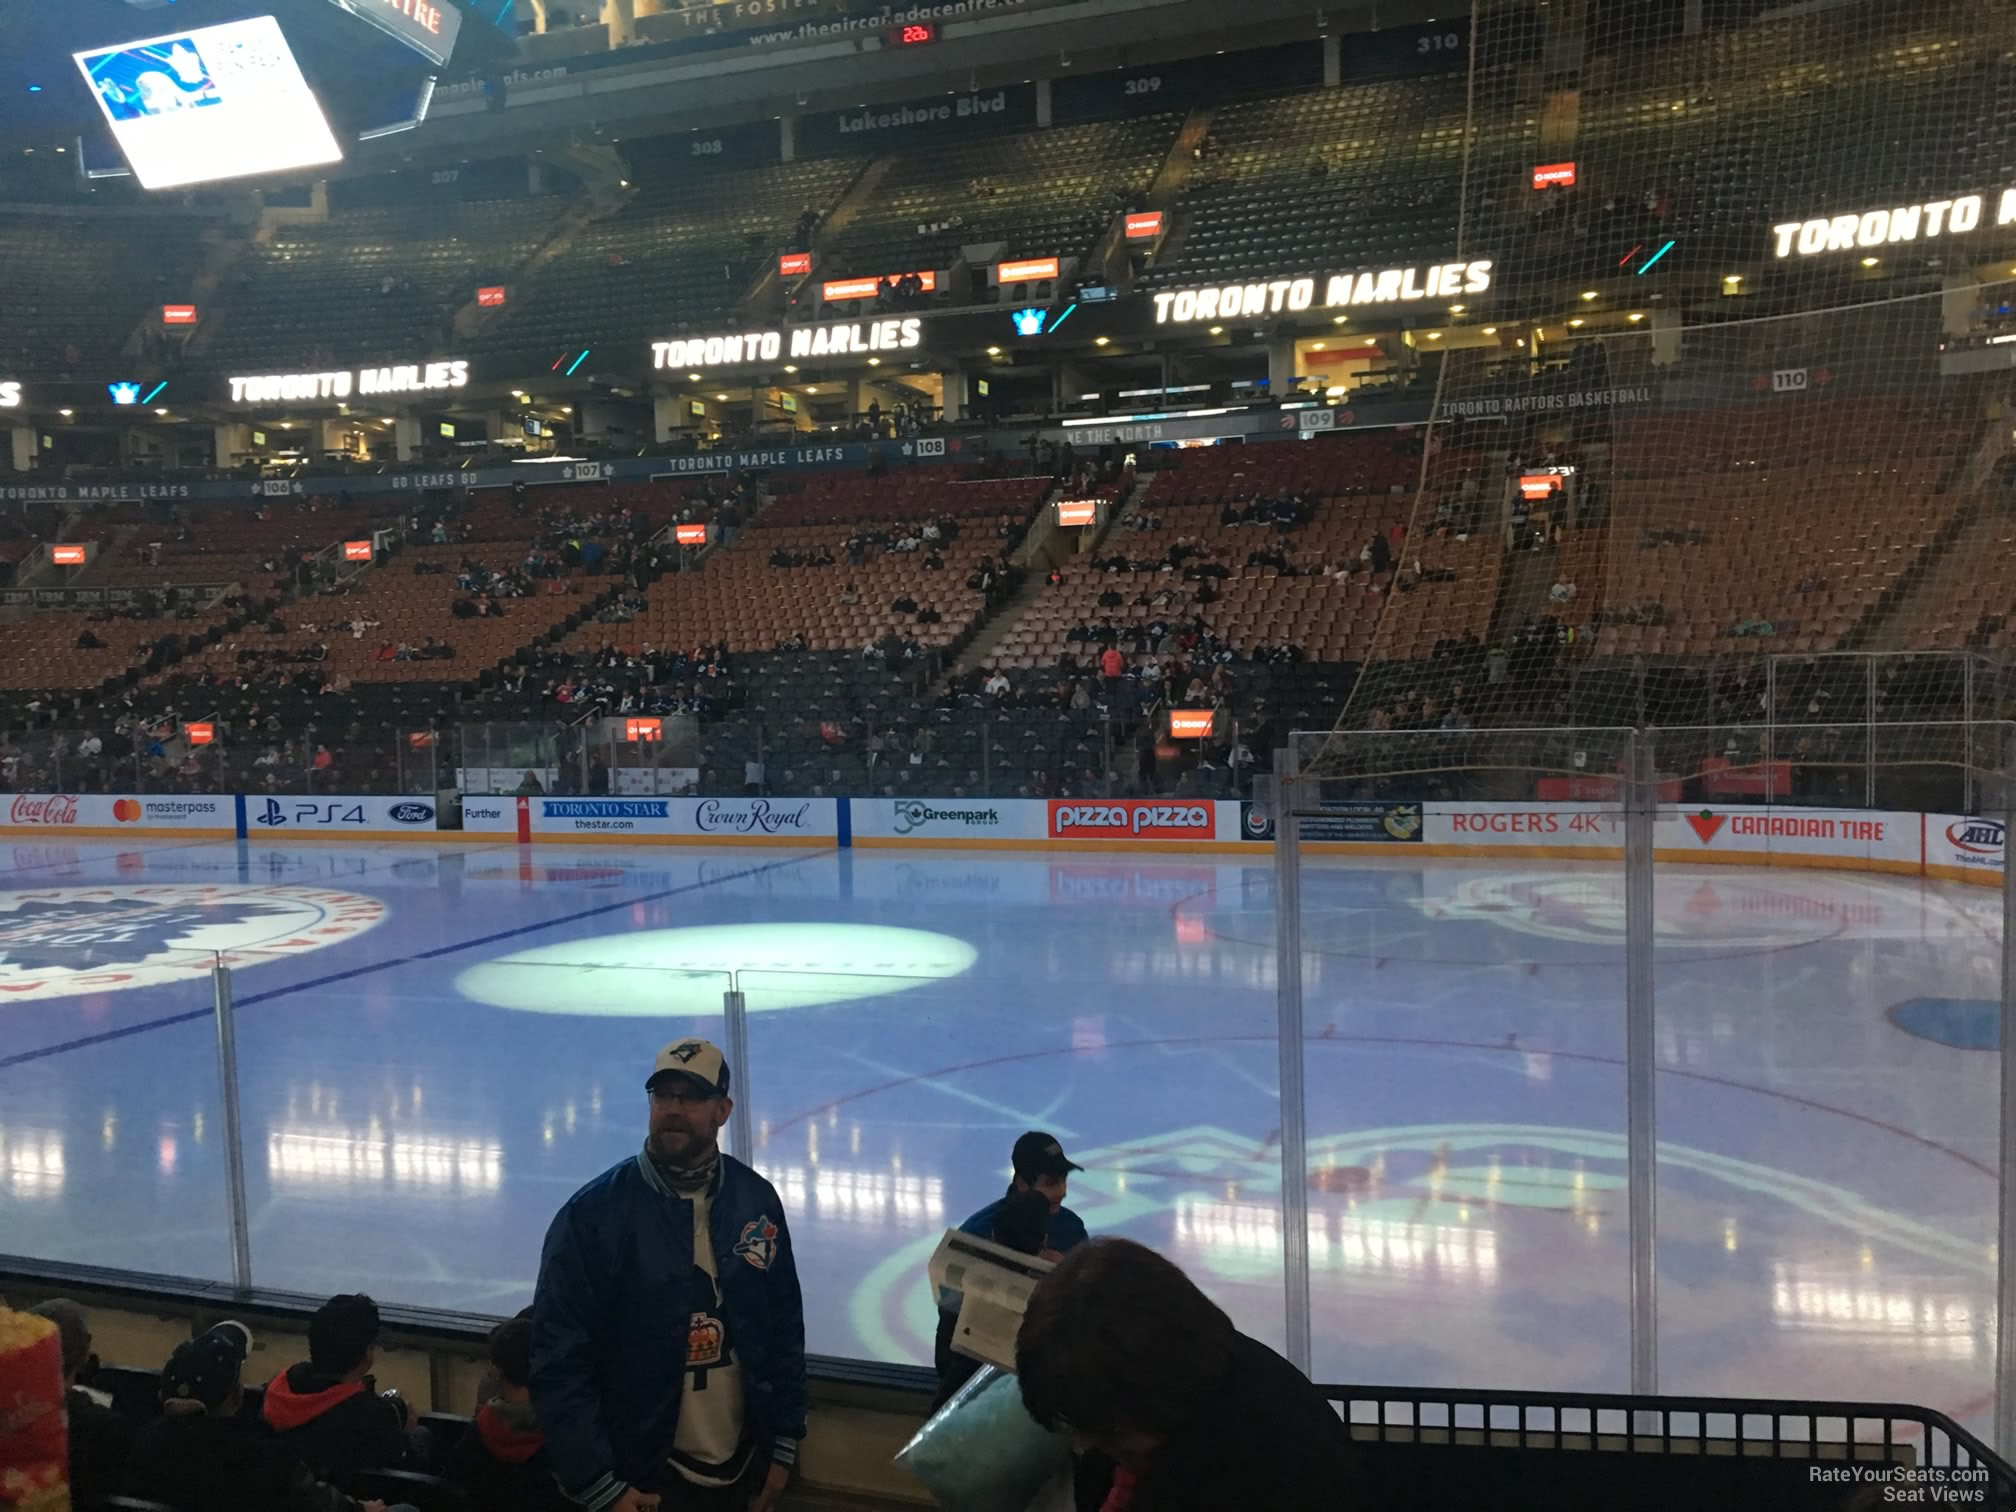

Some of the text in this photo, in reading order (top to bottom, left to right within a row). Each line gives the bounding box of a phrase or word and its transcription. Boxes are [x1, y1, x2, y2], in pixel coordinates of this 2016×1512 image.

[682, 9, 721, 26] THE
[1417, 33, 1459, 52] 310
[1124, 77, 1162, 95] 309
[839, 93, 1006, 134] Lakeshore Blvd
[1773, 194, 1983, 258] TORONTO
[1153, 260, 1493, 324] TORONTO MARLIES
[651, 319, 921, 369] TORONTO MARLIES
[229, 361, 468, 402] TORONTO MARLIES
[1774, 370, 1806, 389] 110
[1441, 387, 1651, 417] TORONTO RAPTORS BASKETBALL
[1302, 411, 1333, 428] 109
[1086, 429, 1111, 443] THE
[1116, 425, 1162, 441] NORTH
[918, 440, 944, 455] 108
[669, 447, 844, 472] TORONTO MAPLE LEAFS
[576, 463, 599, 477] 107
[265, 481, 289, 495] 106
[392, 473, 477, 489] GO LEAFS GO
[0, 485, 189, 499] TORONTO MAPLE LEAFS
[11, 794, 80, 824] Coca-Cola
[146, 801, 216, 814] masterpass
[296, 804, 367, 823] PS4
[397, 805, 427, 821] Ford
[465, 809, 501, 819] Further
[550, 803, 662, 816] TORONTO STAR
[695, 799, 810, 833] Crown Royal
[923, 808, 998, 824] Greenpark
[575, 819, 634, 829] thestar.com
[1056, 806, 1208, 835] pizza pizza
[1452, 813, 1559, 833] ROGERS
[1569, 813, 1601, 833] 4K
[1731, 816, 1884, 841] CANADIAN TIRE
[1959, 826, 2004, 845] AHL
